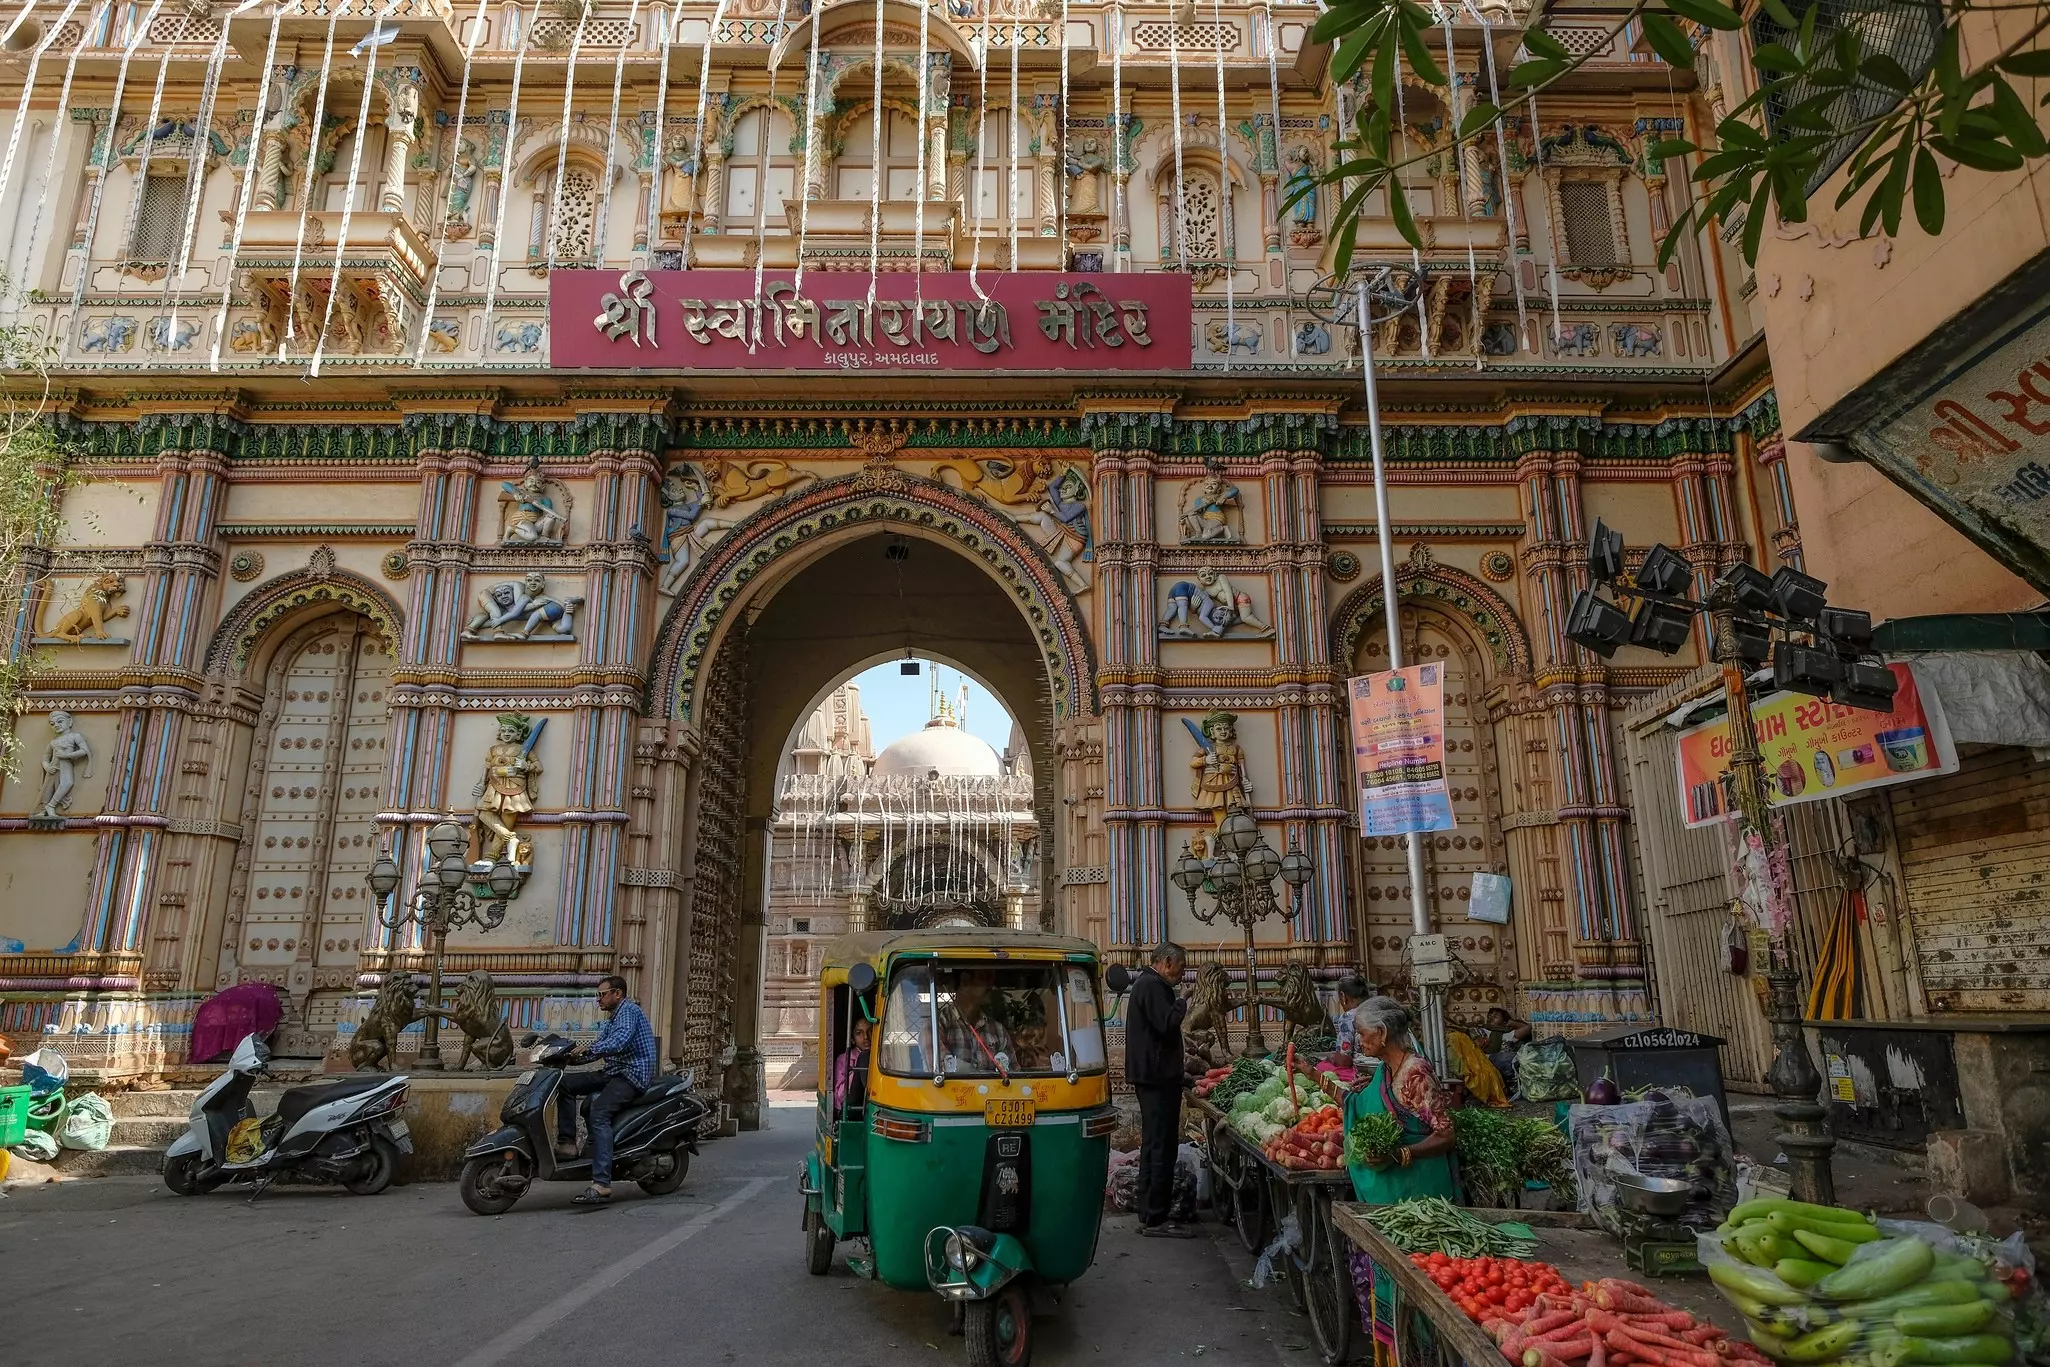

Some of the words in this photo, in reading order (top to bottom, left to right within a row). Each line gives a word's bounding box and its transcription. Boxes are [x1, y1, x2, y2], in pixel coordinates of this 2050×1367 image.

[823, 352, 872, 367] કાલુપુર,
[875, 352, 939, 365] અમદાવાદ
[1831, 727, 1863, 743] કાઉન્ટર
[1379, 759, 1403, 769] Helpline
